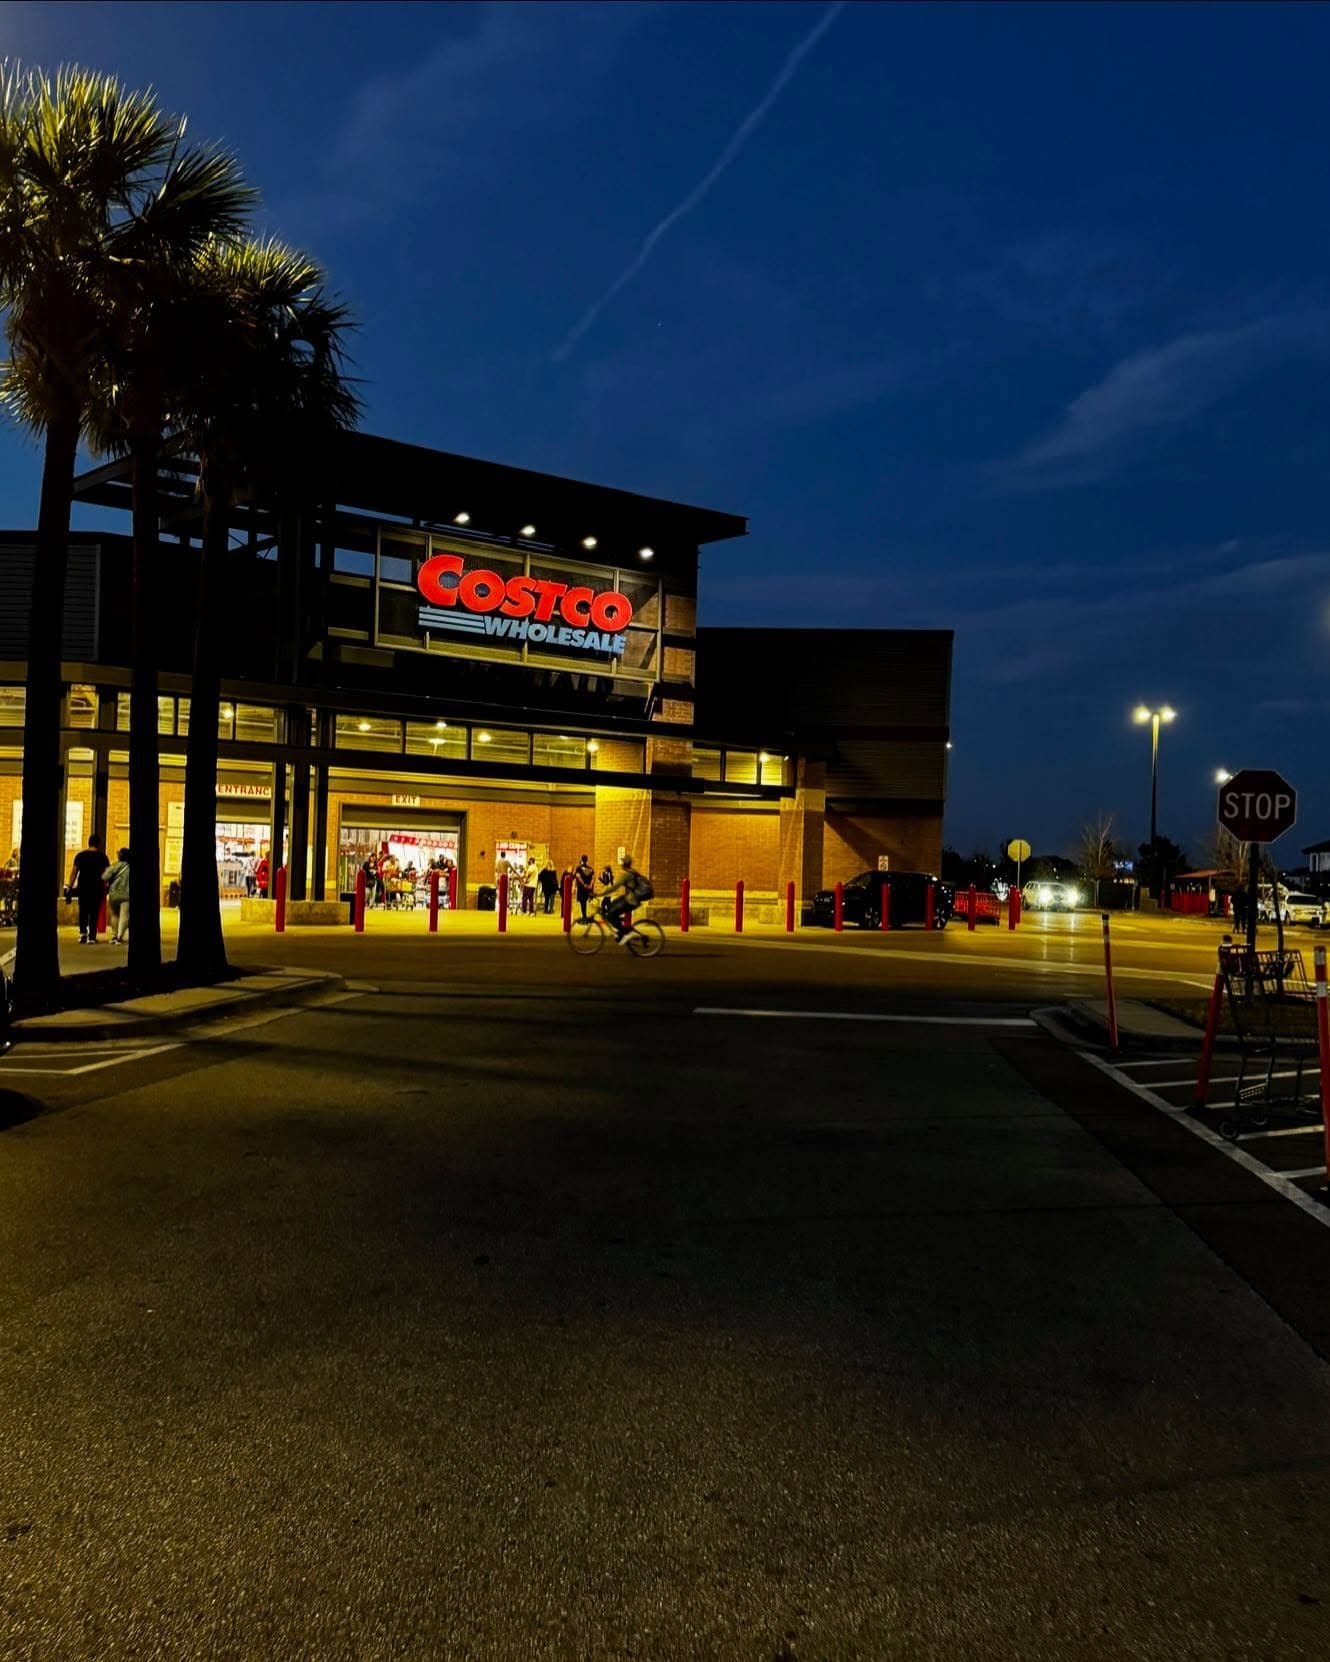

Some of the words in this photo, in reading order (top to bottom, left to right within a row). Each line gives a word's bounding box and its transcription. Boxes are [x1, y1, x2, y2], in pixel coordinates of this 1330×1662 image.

[417, 554, 633, 632] COSTCO
[482, 615, 627, 654] WHOLESALE
[218, 784, 271, 796] ENTRANC
[395, 792, 417, 804] EXIT
[1223, 791, 1291, 820] STOP
